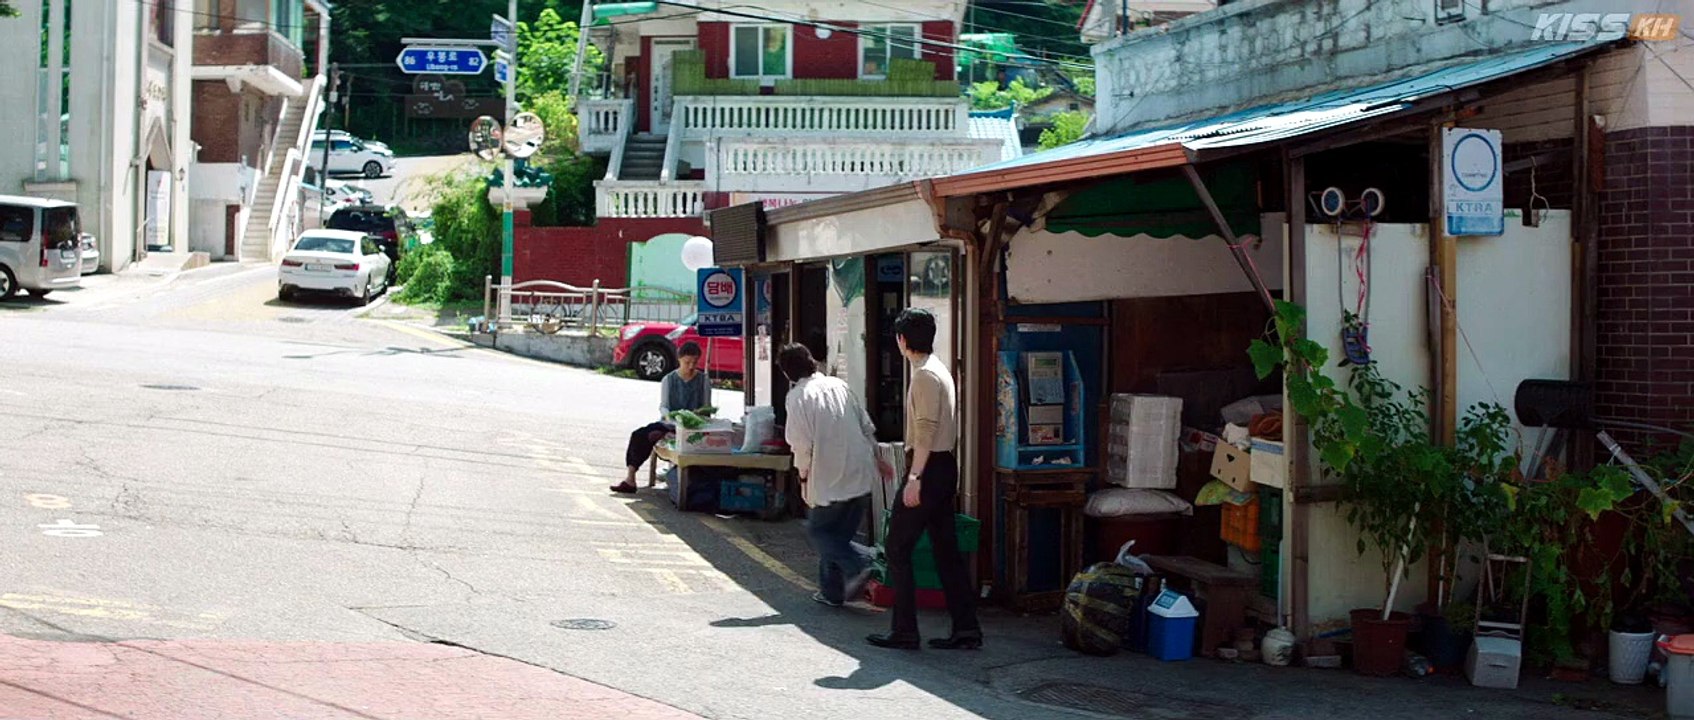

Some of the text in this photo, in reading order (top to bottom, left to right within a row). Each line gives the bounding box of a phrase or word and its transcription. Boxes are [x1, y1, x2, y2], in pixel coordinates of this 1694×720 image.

[403, 55, 416, 65] 86
[468, 57, 480, 66] 82
[707, 281, 733, 295] 담배
